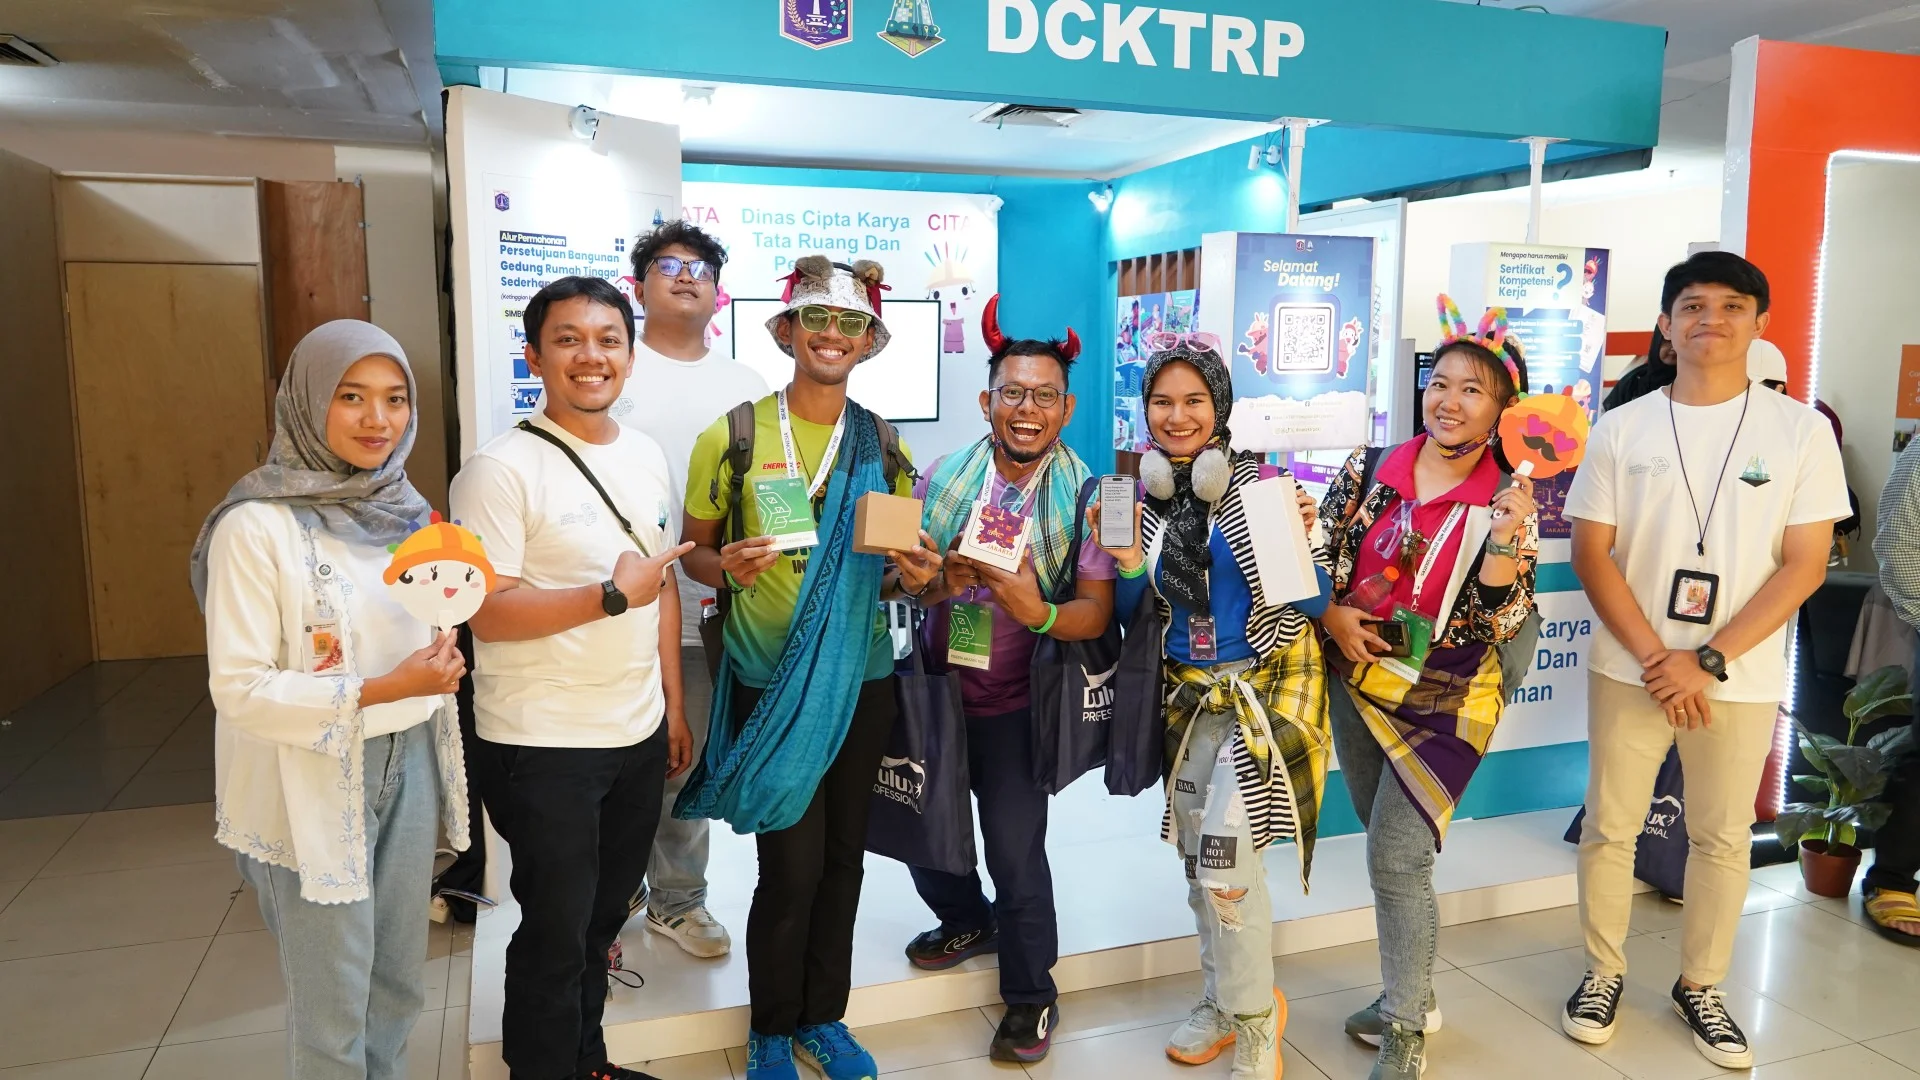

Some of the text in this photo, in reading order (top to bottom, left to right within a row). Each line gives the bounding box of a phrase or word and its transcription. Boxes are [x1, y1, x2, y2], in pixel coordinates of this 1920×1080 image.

[988, 0, 1306, 77] DCKTRP
[741, 208, 911, 232] Dinas Cipta Karya
[501, 232, 566, 246] Alur Permohonan
[752, 232, 901, 254] Tata Ruang Dan
[500, 245, 620, 264] Persetujuan Bangunan
[1500, 251, 1527, 260] Mengapa
[1527, 252, 1544, 260] harus
[500, 261, 619, 279] Gedung Rumah Tinggal
[1263, 259, 1319, 273] Selamat
[1499, 264, 1545, 275] Sertifikat
[501, 276, 551, 288] Sederhan
[1278, 272, 1340, 292] Datang!
[1499, 275, 1554, 289] Kompetensi
[1498, 286, 1527, 300] Kerja
[1537, 649, 1578, 670] Dan
[1177, 780, 1195, 792] BAG
[1211, 838, 1220, 847] IN
[1206, 848, 1226, 857] HOT
[1202, 856, 1231, 867] WATER
